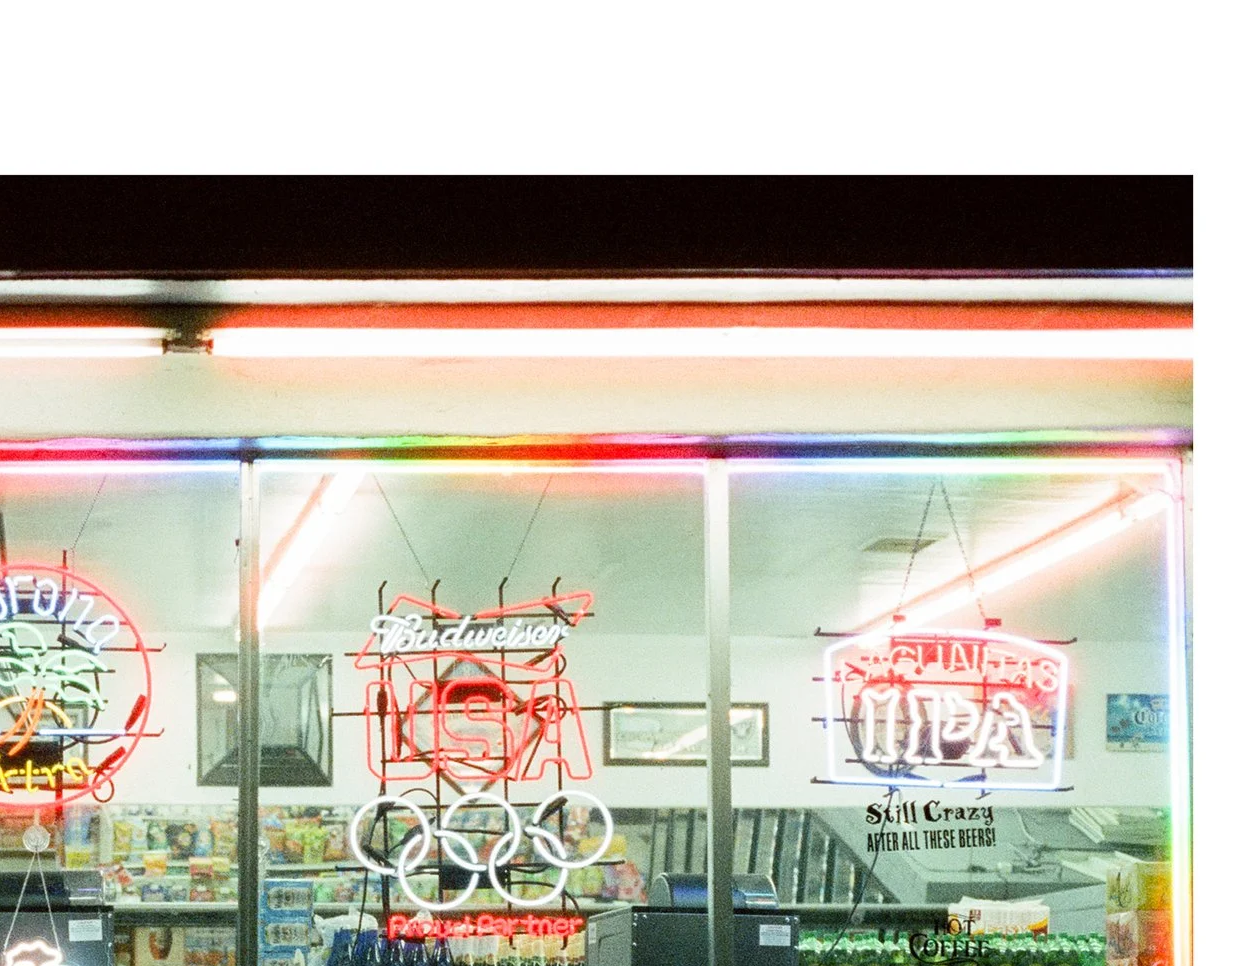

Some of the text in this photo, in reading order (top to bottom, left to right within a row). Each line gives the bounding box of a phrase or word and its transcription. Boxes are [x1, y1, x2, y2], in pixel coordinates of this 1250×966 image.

[370, 613, 570, 652] Budweiser
[366, 676, 594, 782] USA
[865, 800, 994, 826] Still Crazy
[867, 827, 997, 852] AFTER ALL THESE BEERS!
[388, 912, 584, 939] Proud Partner
[933, 917, 976, 936] HOT
[909, 933, 992, 964] COFFEE
